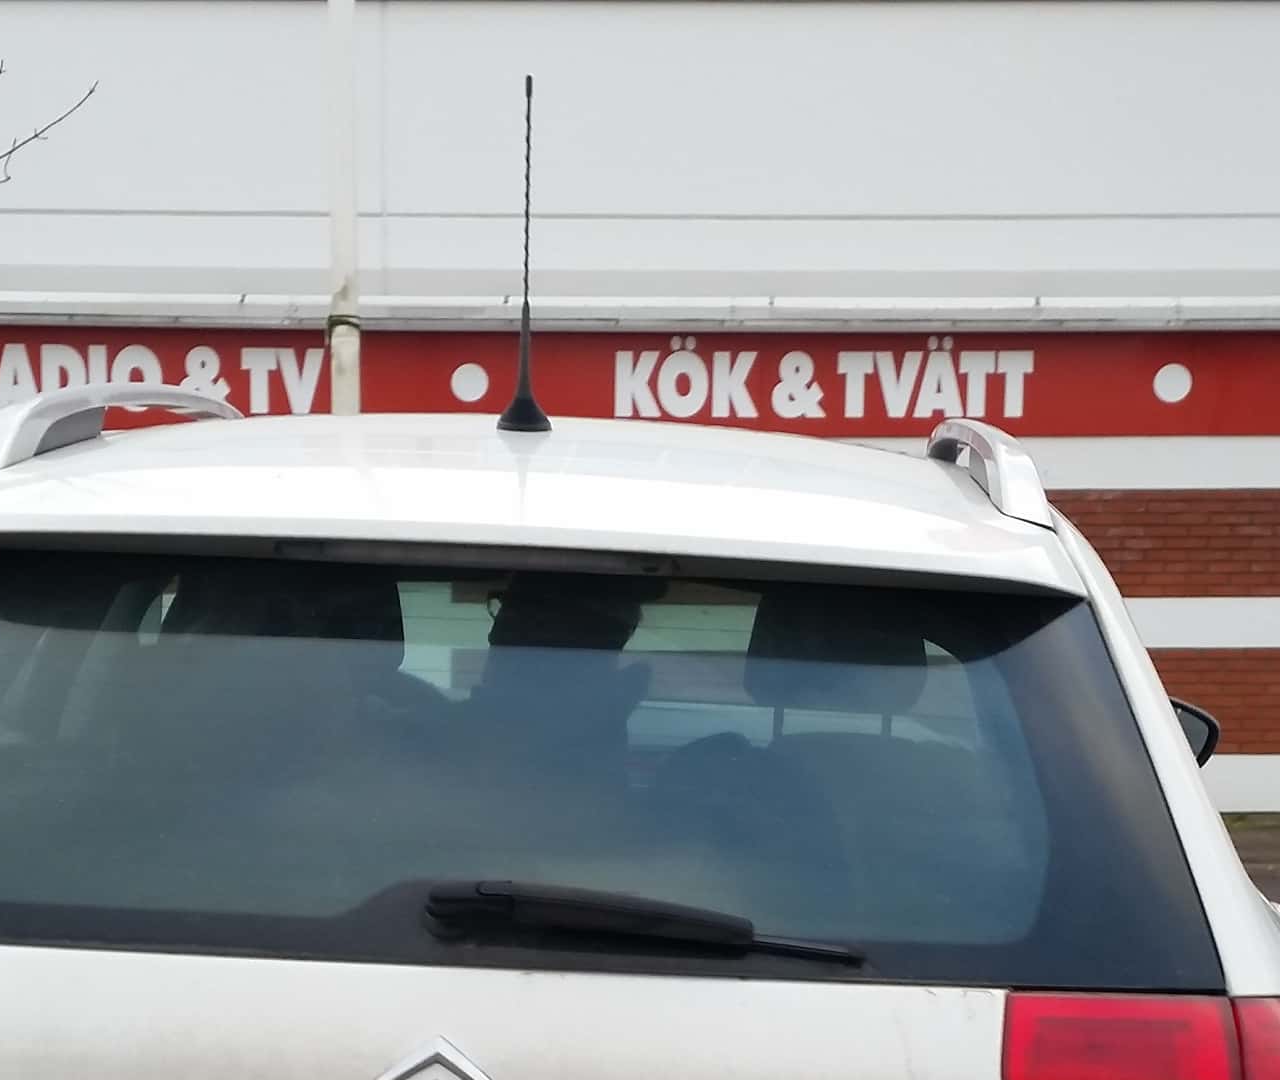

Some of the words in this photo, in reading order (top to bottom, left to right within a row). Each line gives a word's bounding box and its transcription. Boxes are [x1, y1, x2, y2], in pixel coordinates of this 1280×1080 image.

[172, 346, 231, 412] &
[241, 347, 324, 414] TV
[614, 335, 759, 418] KÖK
[771, 350, 825, 418] &
[837, 335, 1035, 418] TVÄTT
